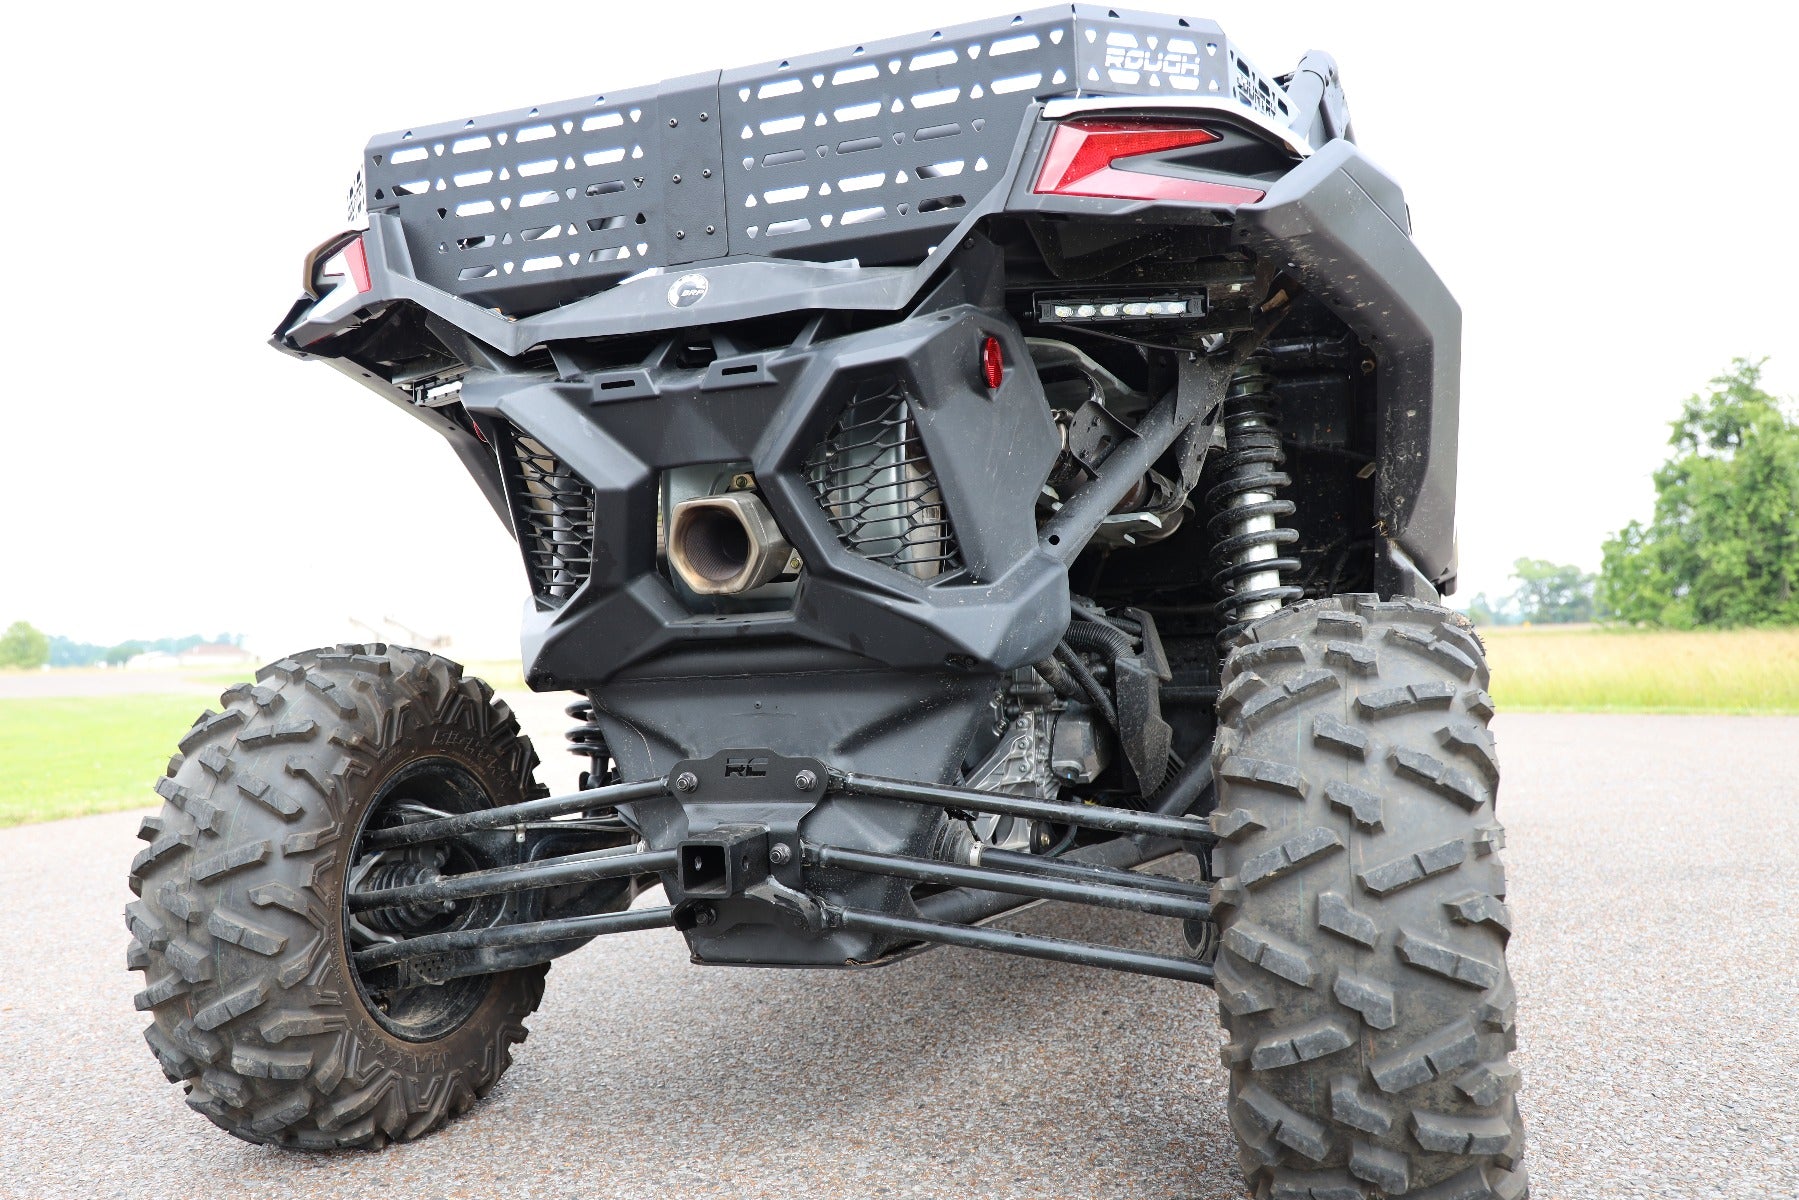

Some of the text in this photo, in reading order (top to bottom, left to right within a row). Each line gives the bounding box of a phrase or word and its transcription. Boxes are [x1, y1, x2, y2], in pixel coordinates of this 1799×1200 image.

[1105, 47, 1200, 76] ROUGH
[681, 289, 705, 297] BRP
[725, 758, 769, 777] RC
